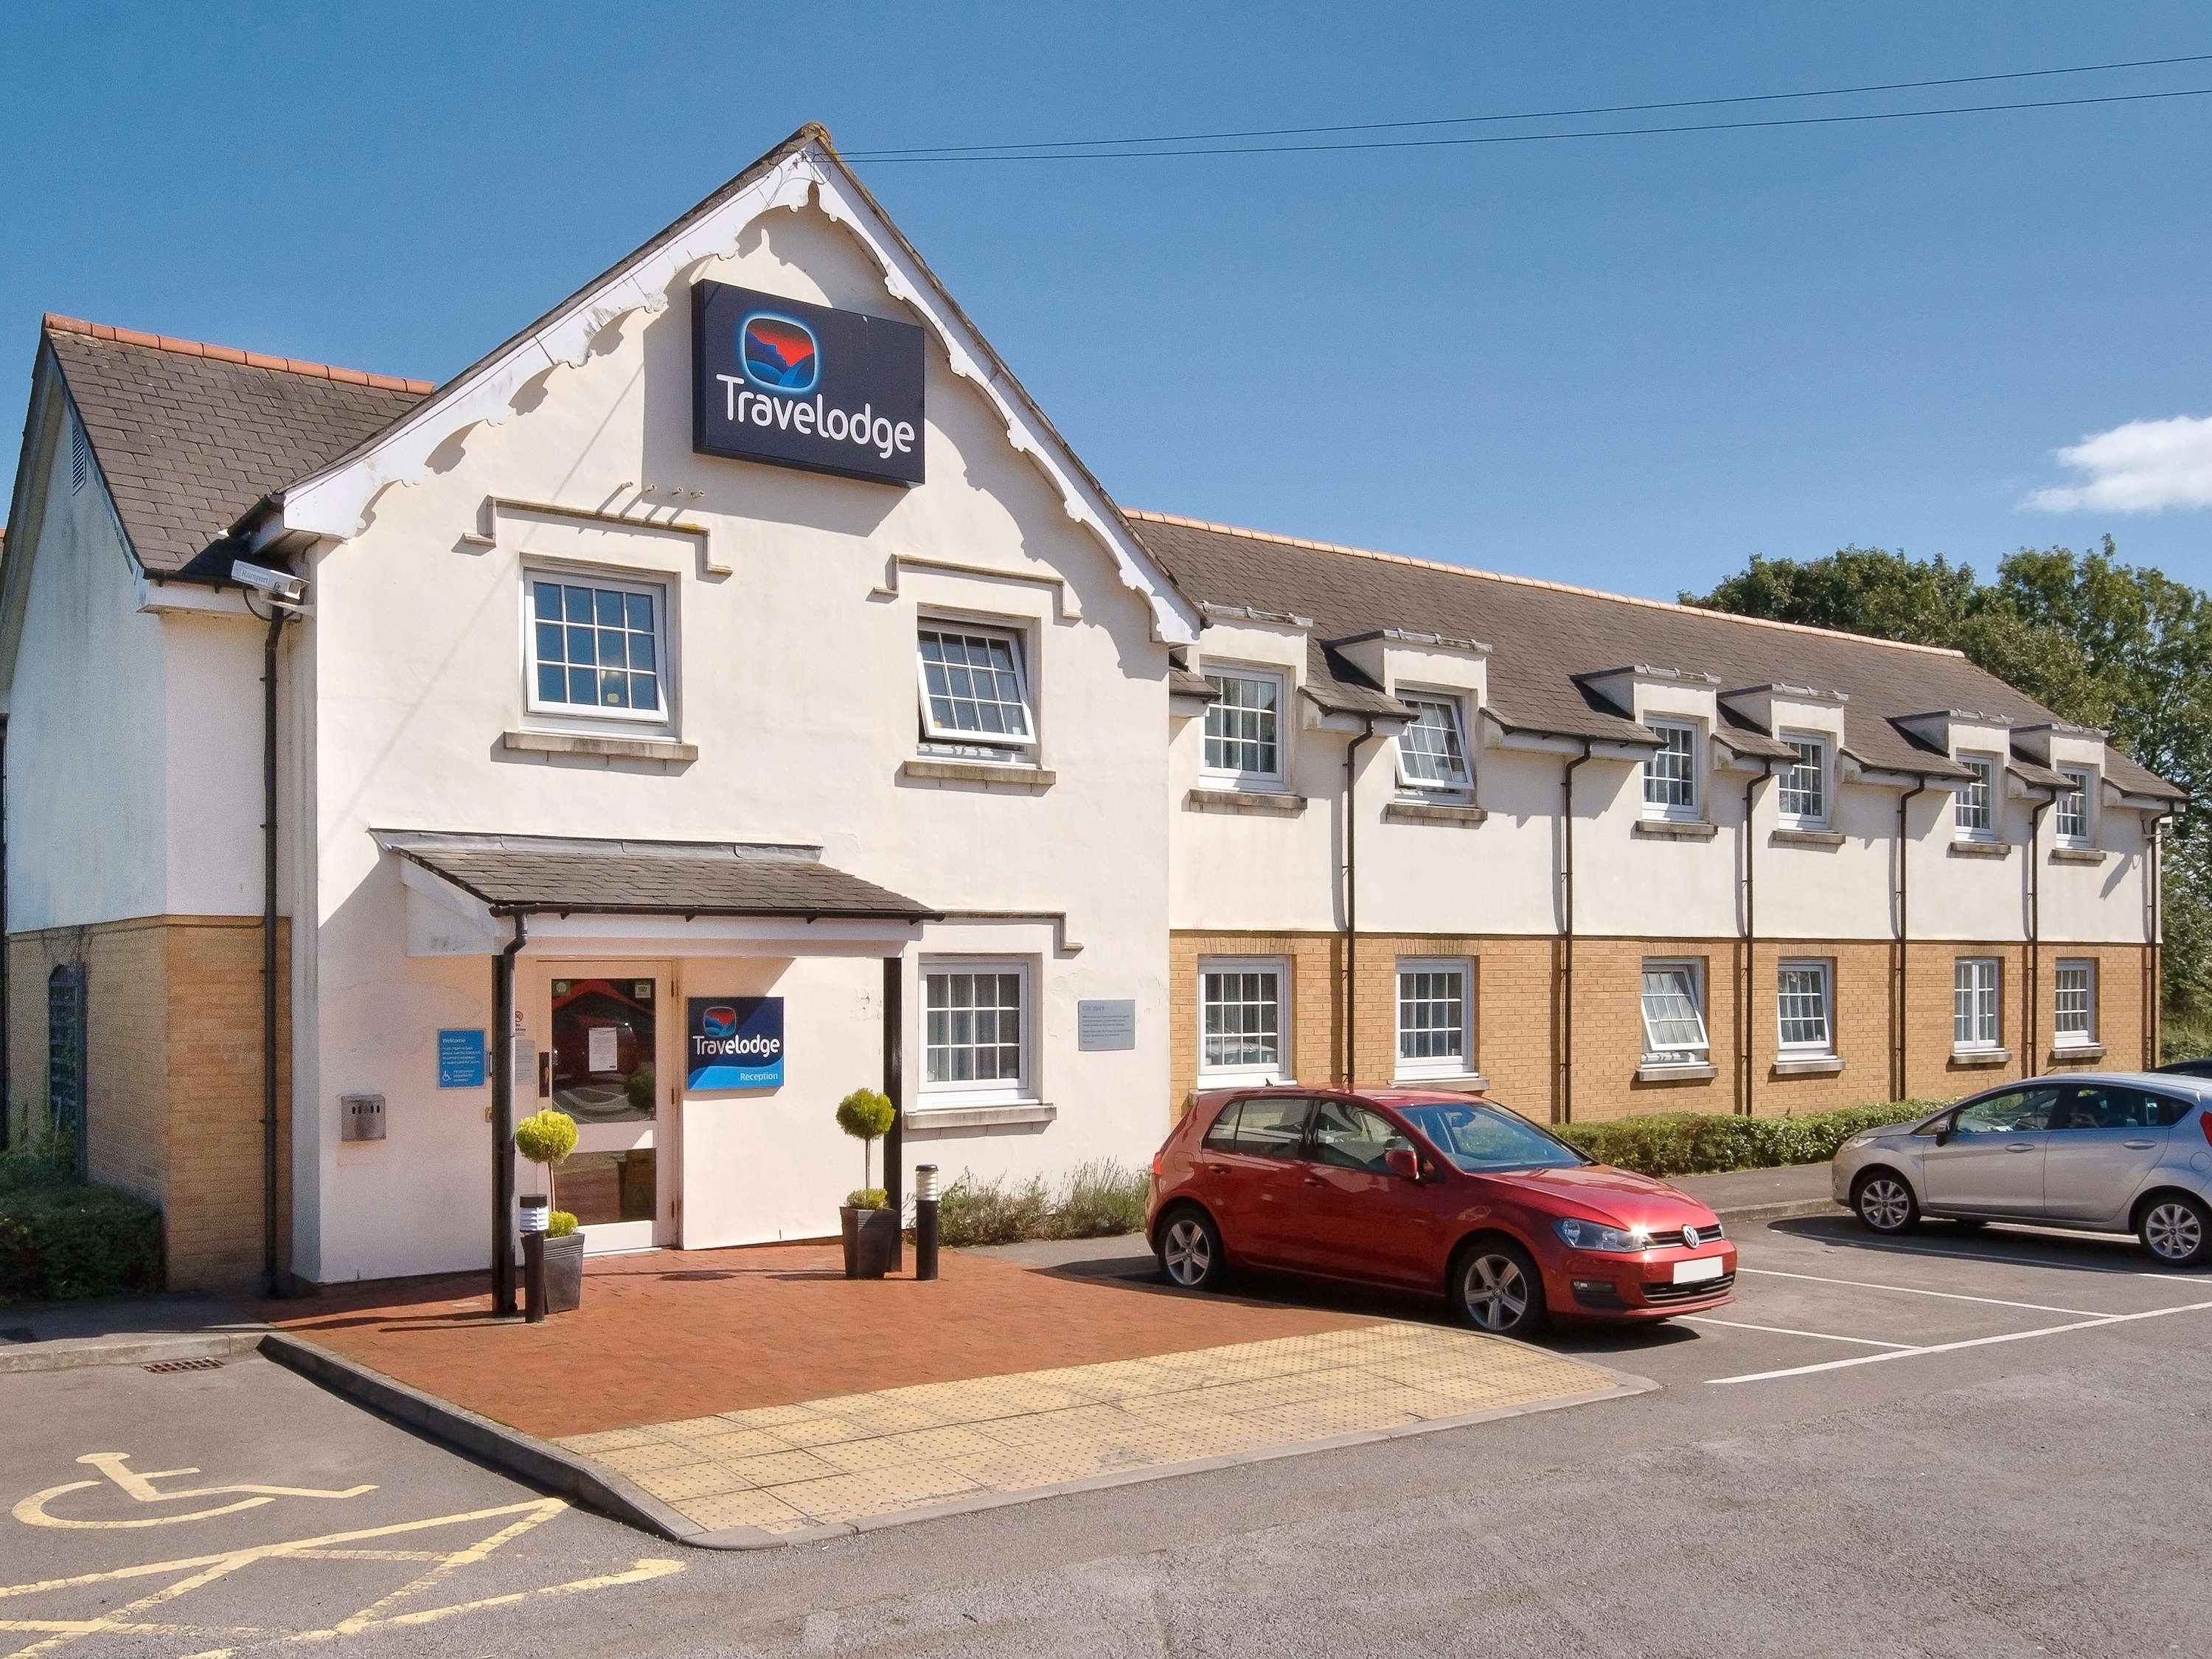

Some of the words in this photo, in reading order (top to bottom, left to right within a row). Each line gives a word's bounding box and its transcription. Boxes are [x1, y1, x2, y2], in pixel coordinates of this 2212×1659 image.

[716, 373, 915, 459] Travelodge
[692, 1034, 780, 1058] Travelodge
[740, 1072, 779, 1082] Reception
